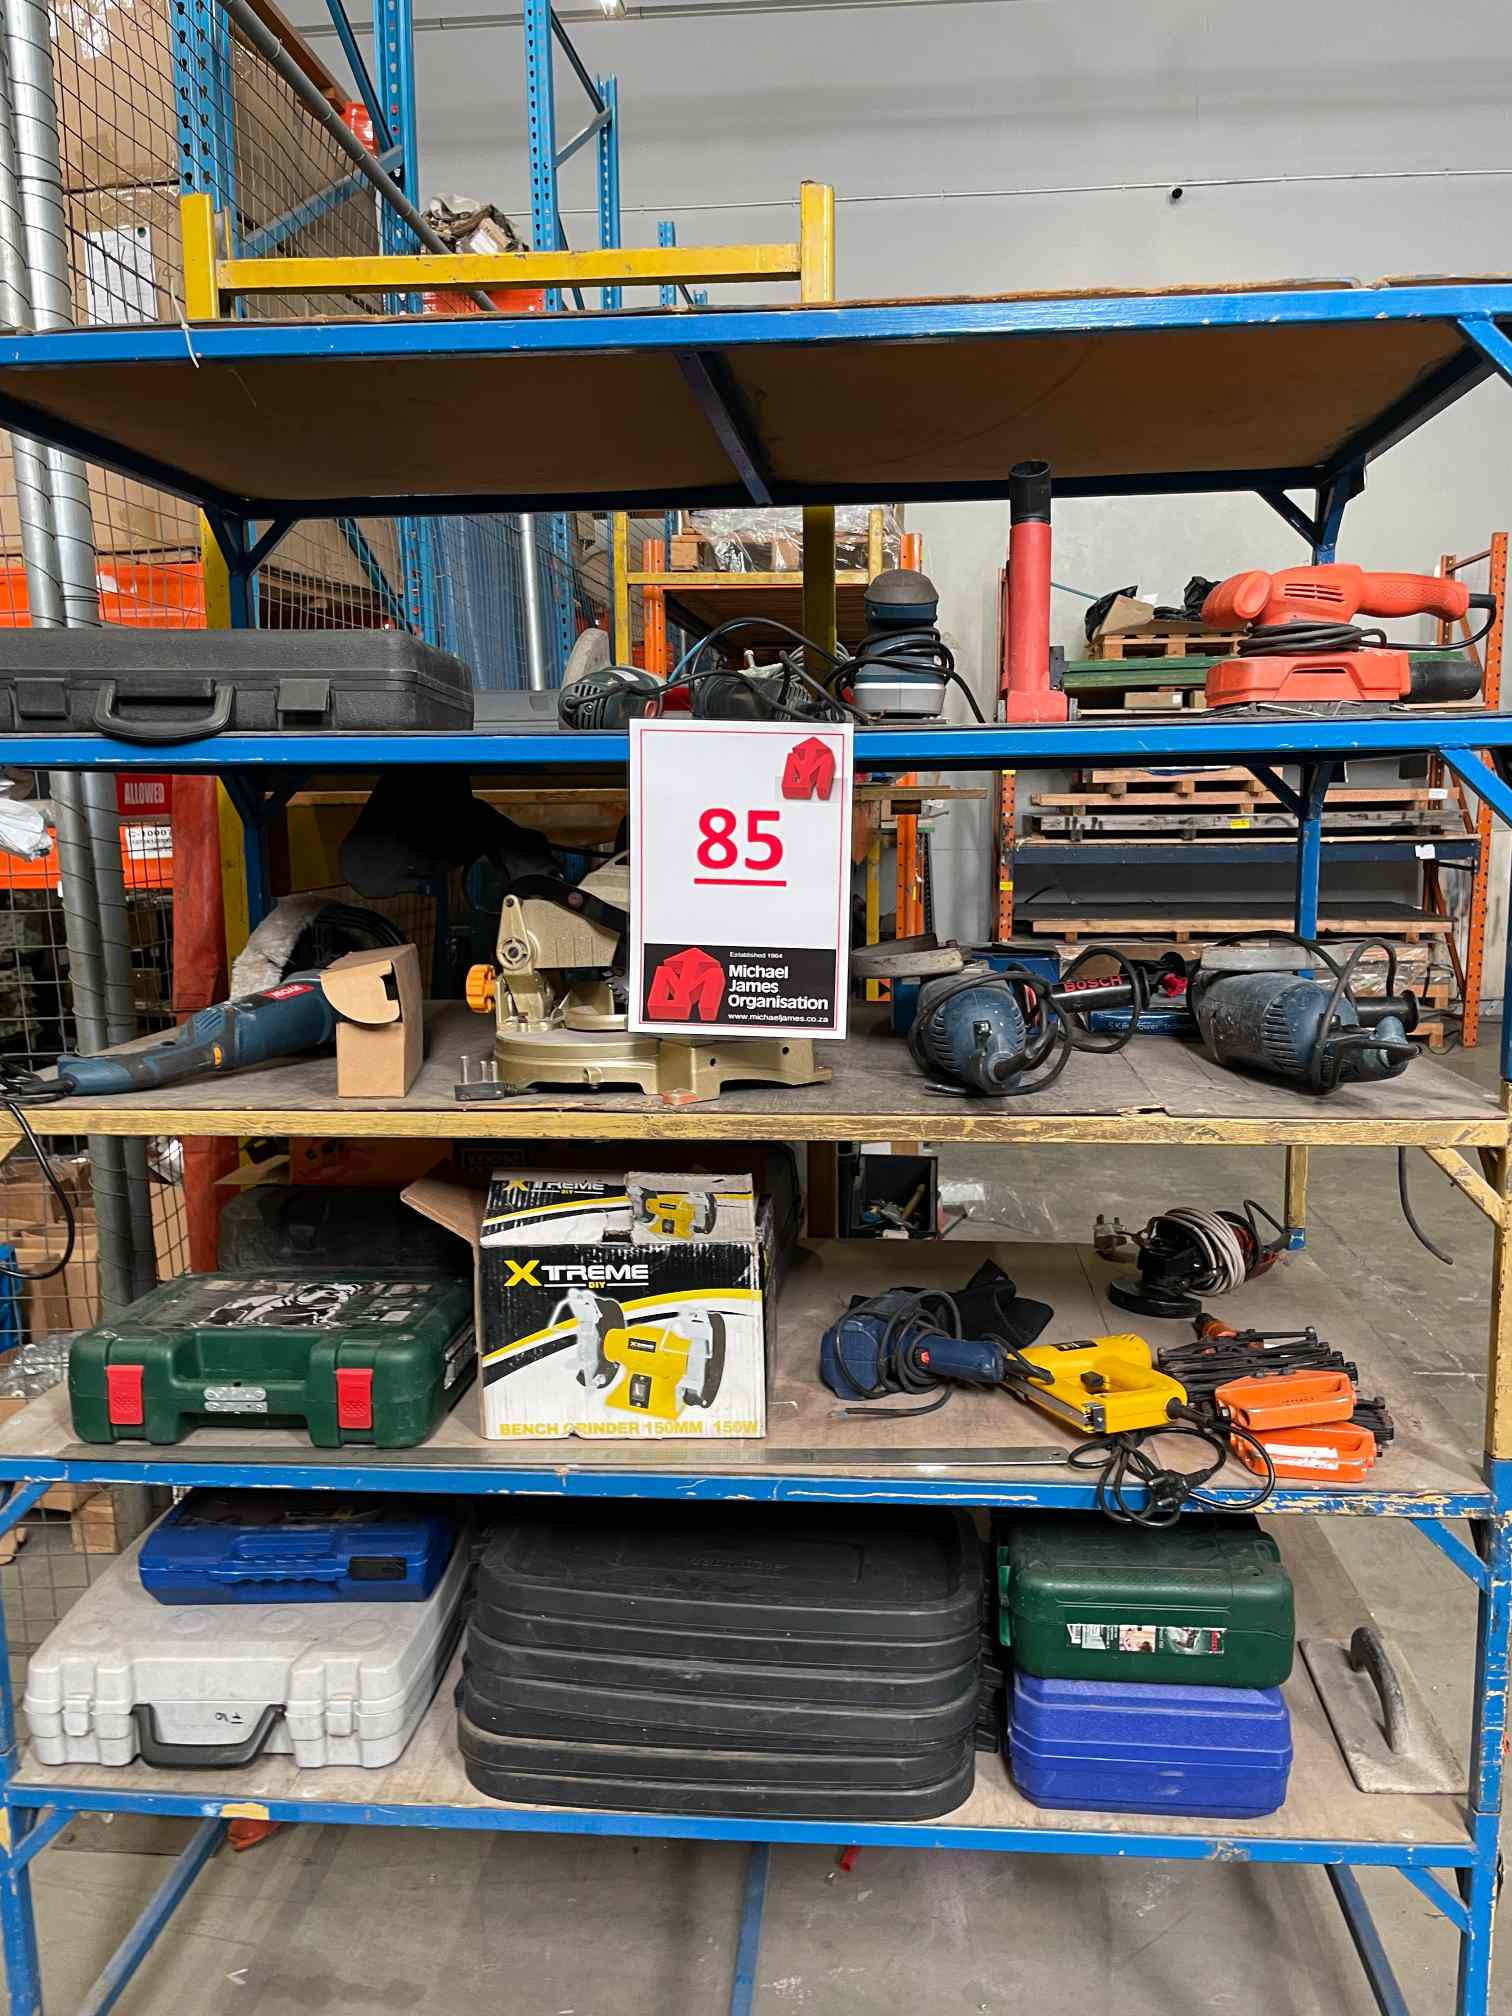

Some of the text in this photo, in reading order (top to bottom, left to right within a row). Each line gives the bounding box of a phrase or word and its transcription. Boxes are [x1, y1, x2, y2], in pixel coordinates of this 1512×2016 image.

[124, 783, 165, 804] ALLOWED
[697, 808, 783, 871] 85
[728, 965, 789, 979] Michael
[728, 980, 779, 993] James
[1063, 976, 1123, 993] BOSCH
[727, 994, 829, 1010] Organisation
[727, 1013, 829, 1023] www.michaeljames.co.za
[504, 1260, 649, 1287] XTREME
[588, 1281, 606, 1289] DIY
[499, 1423, 559, 1435] BENCH
[644, 1421, 704, 1434] 150MM
[713, 1420, 758, 1434] 150W
